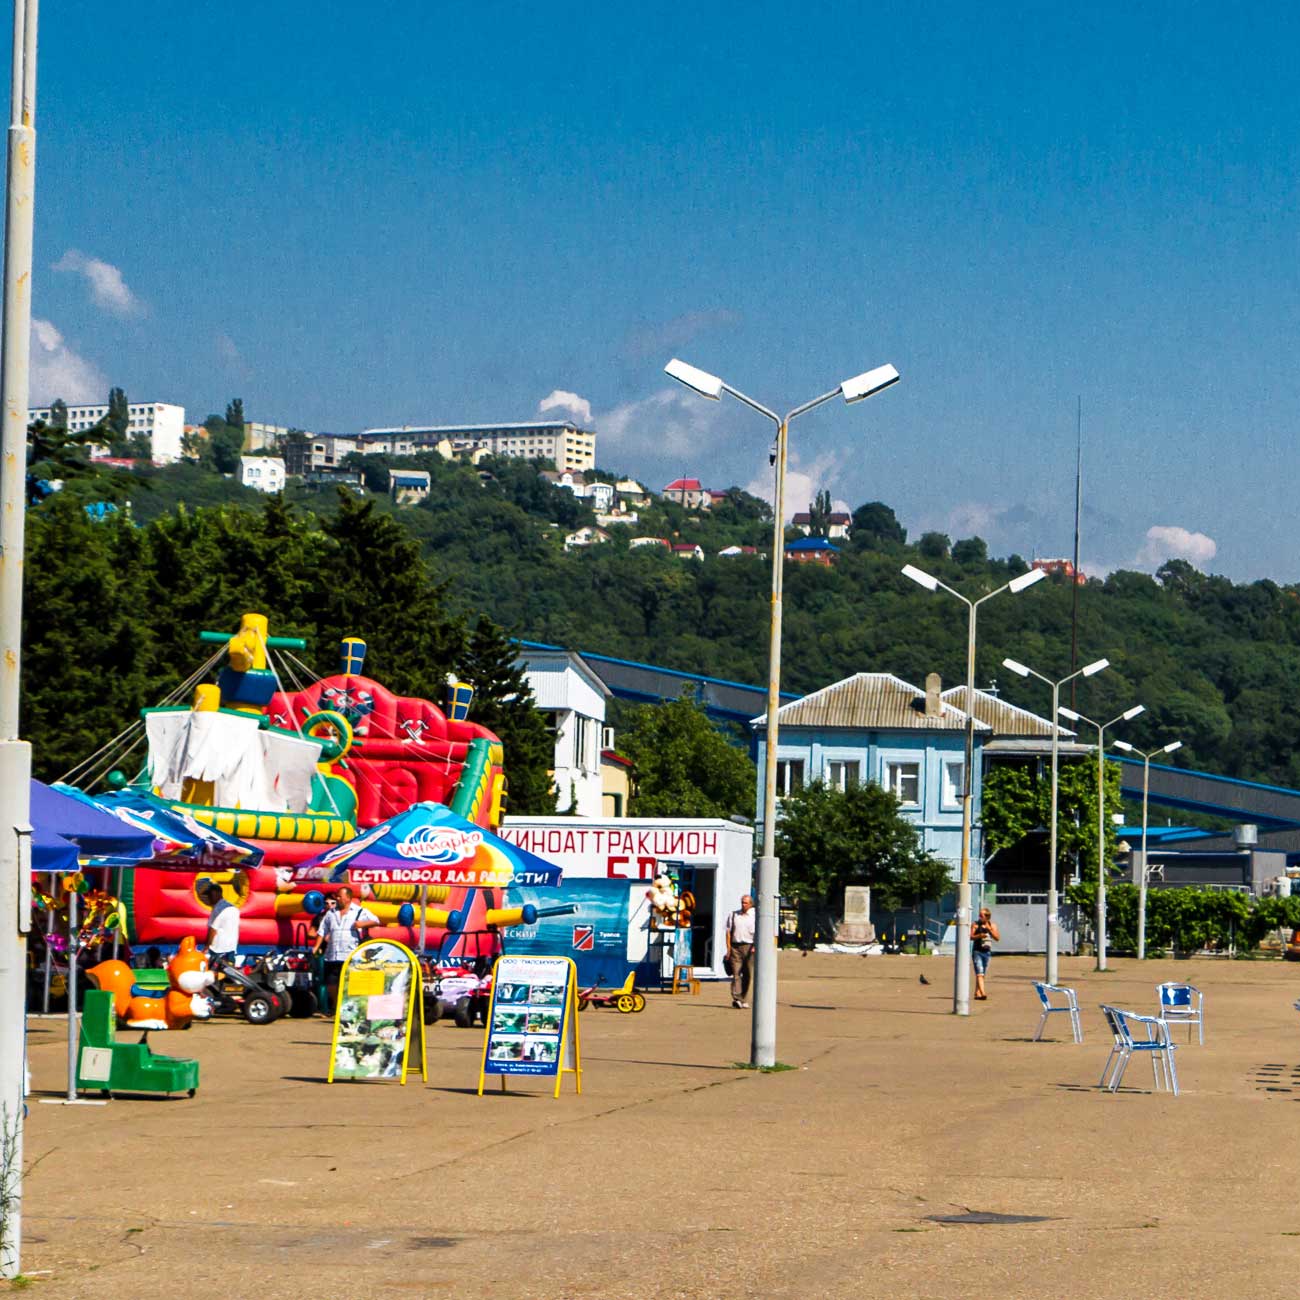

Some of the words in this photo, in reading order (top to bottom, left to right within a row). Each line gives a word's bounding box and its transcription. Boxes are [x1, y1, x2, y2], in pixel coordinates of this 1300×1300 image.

[352, 868, 390, 882] ЕСТЬ
[392, 868, 442, 883] ПОВОД
[445, 869, 476, 884] ДЛЯ
